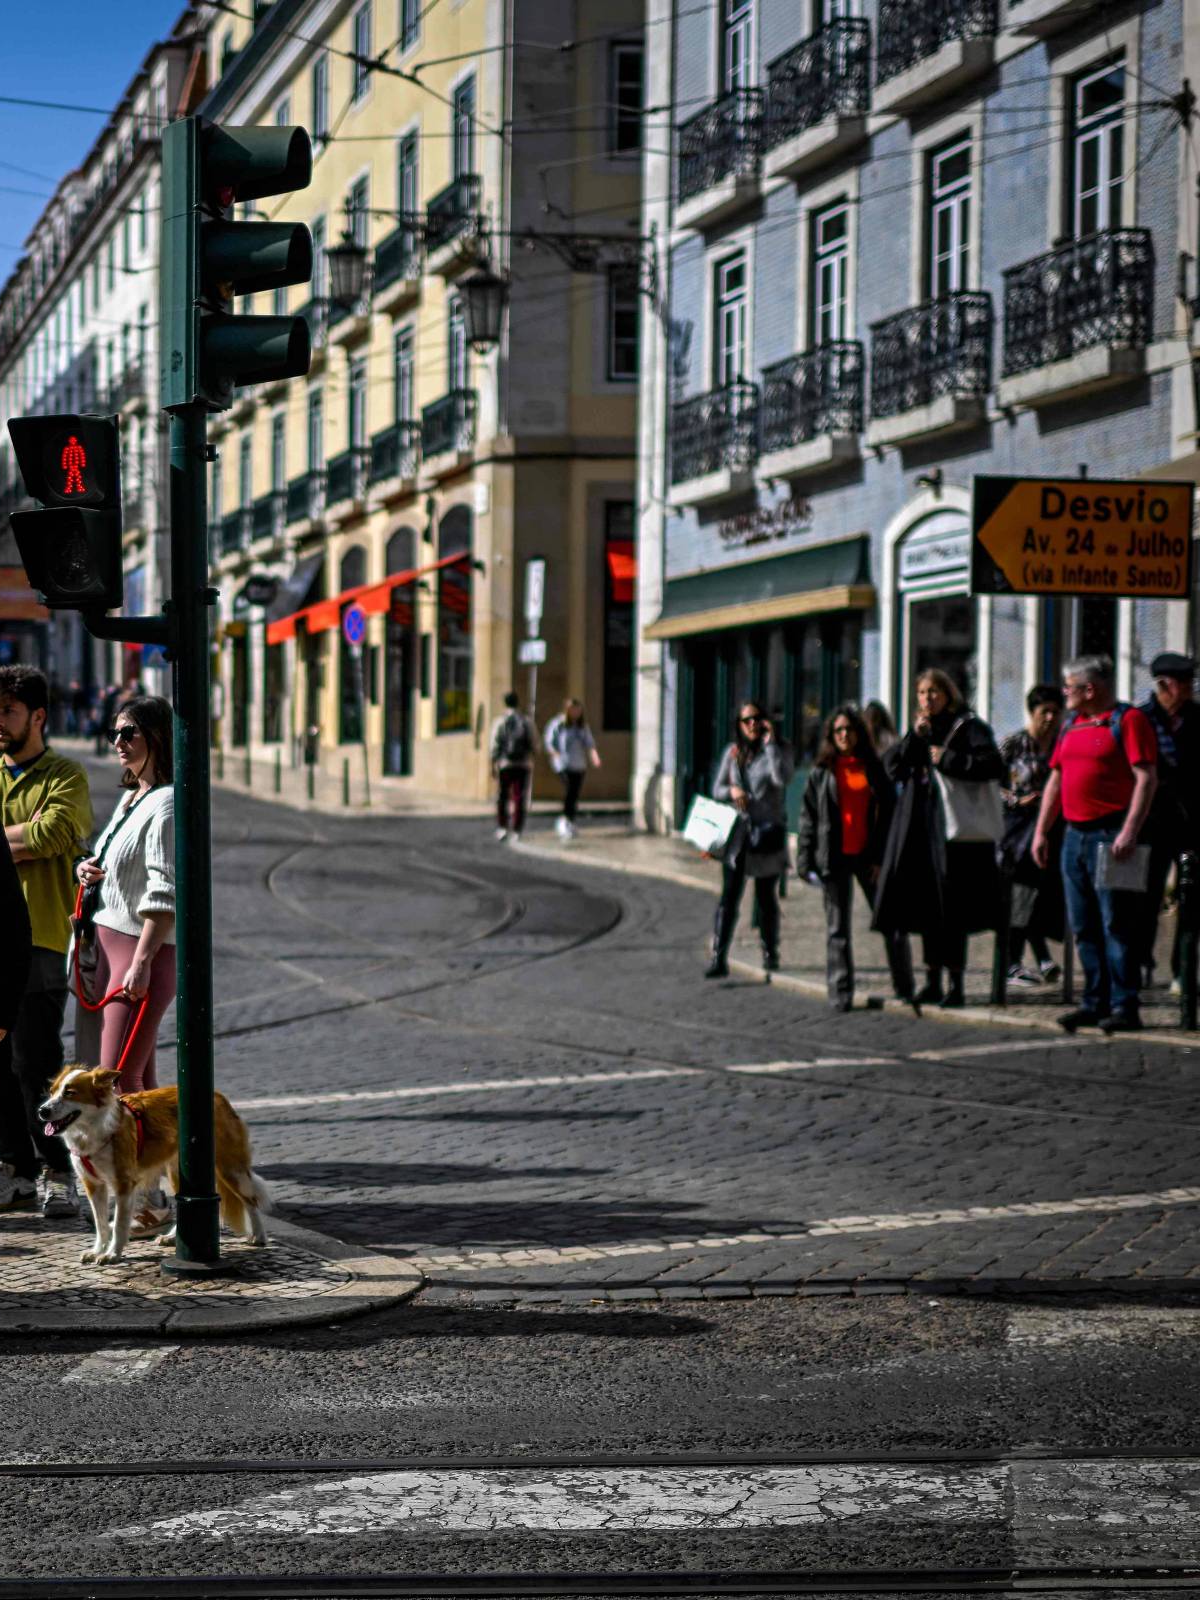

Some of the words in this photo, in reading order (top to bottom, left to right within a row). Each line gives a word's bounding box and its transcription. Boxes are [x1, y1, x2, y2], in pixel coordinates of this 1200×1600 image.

[1040, 487, 1169, 523] Desvio
[1023, 528, 1056, 555] Av.
[1066, 528, 1095, 556] 24
[1126, 530, 1185, 558] Julho
[1023, 562, 1053, 585] (via
[1062, 564, 1118, 586] Infante
[1126, 566, 1181, 589] Santo)
